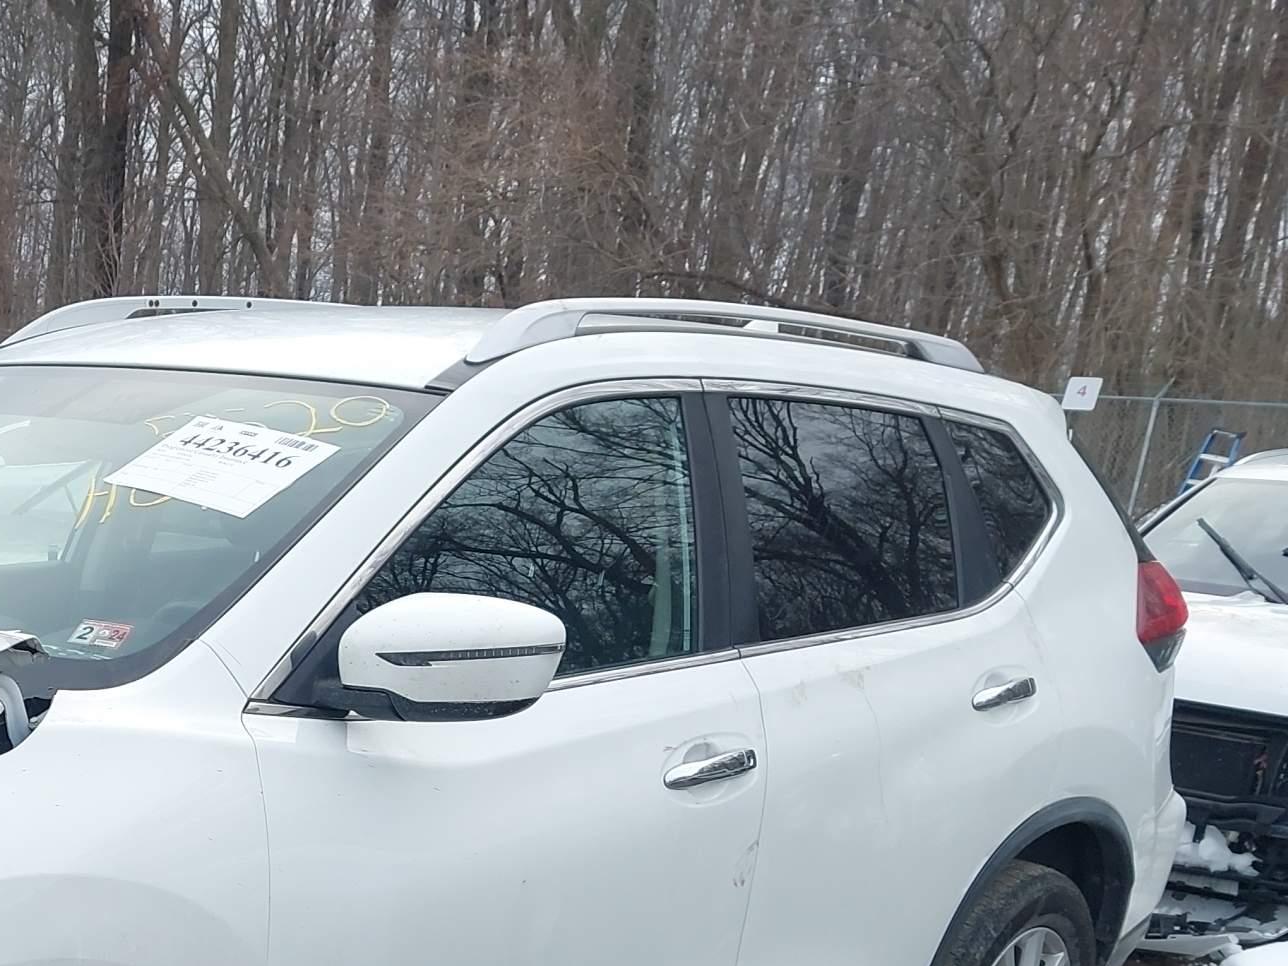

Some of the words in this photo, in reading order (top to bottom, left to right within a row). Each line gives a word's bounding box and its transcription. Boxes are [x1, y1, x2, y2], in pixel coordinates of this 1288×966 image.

[1077, 385, 1088, 397] 4
[181, 433, 301, 469] 44236416
[75, 626, 95, 640] 2
